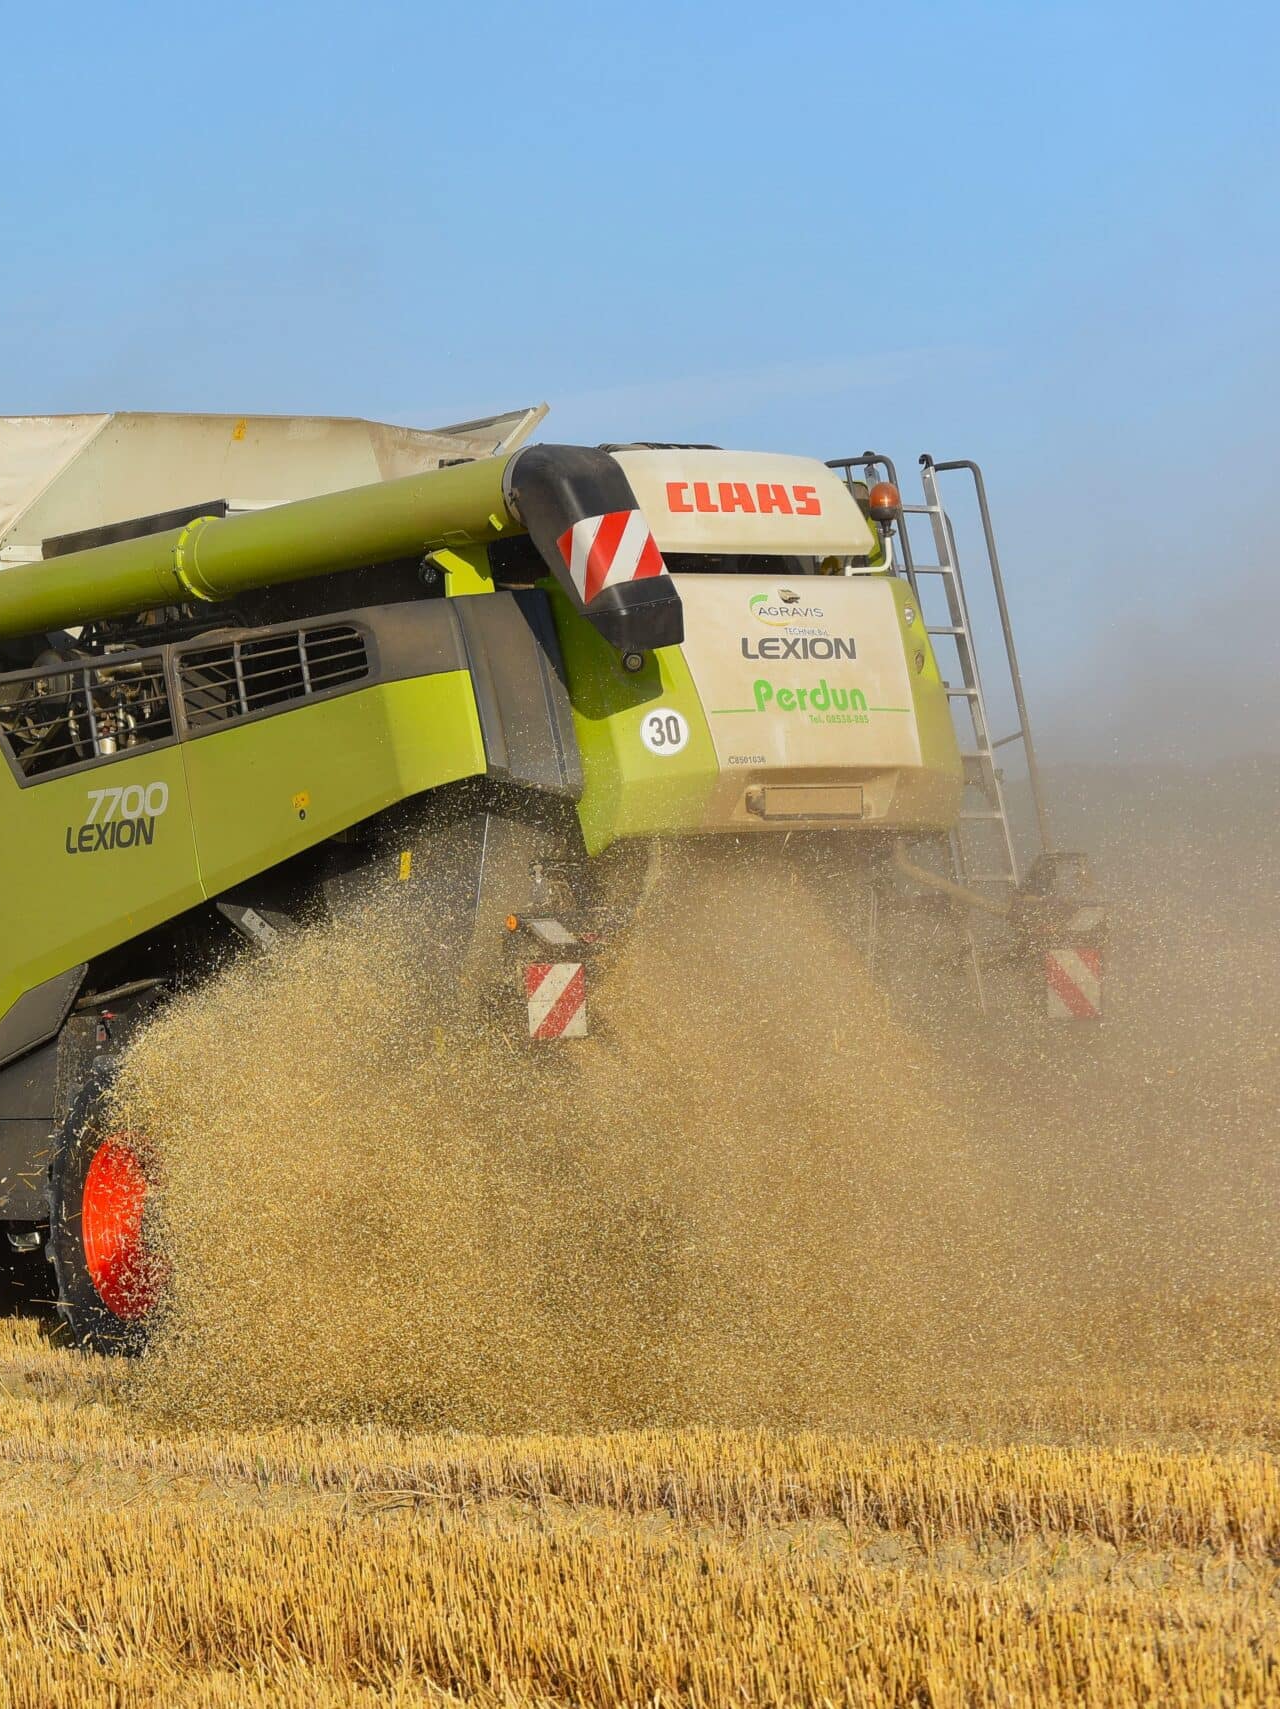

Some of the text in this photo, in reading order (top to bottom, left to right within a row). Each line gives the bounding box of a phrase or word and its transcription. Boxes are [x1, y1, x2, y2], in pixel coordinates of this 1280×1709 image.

[665, 482, 822, 516] CLAAS
[758, 606, 824, 618] AGRAVIS
[741, 637, 857, 660] LEXION
[753, 679, 868, 713] Perdun
[648, 715, 681, 747] 30
[86, 782, 169, 825] 7700
[65, 816, 155, 855] LEXION
